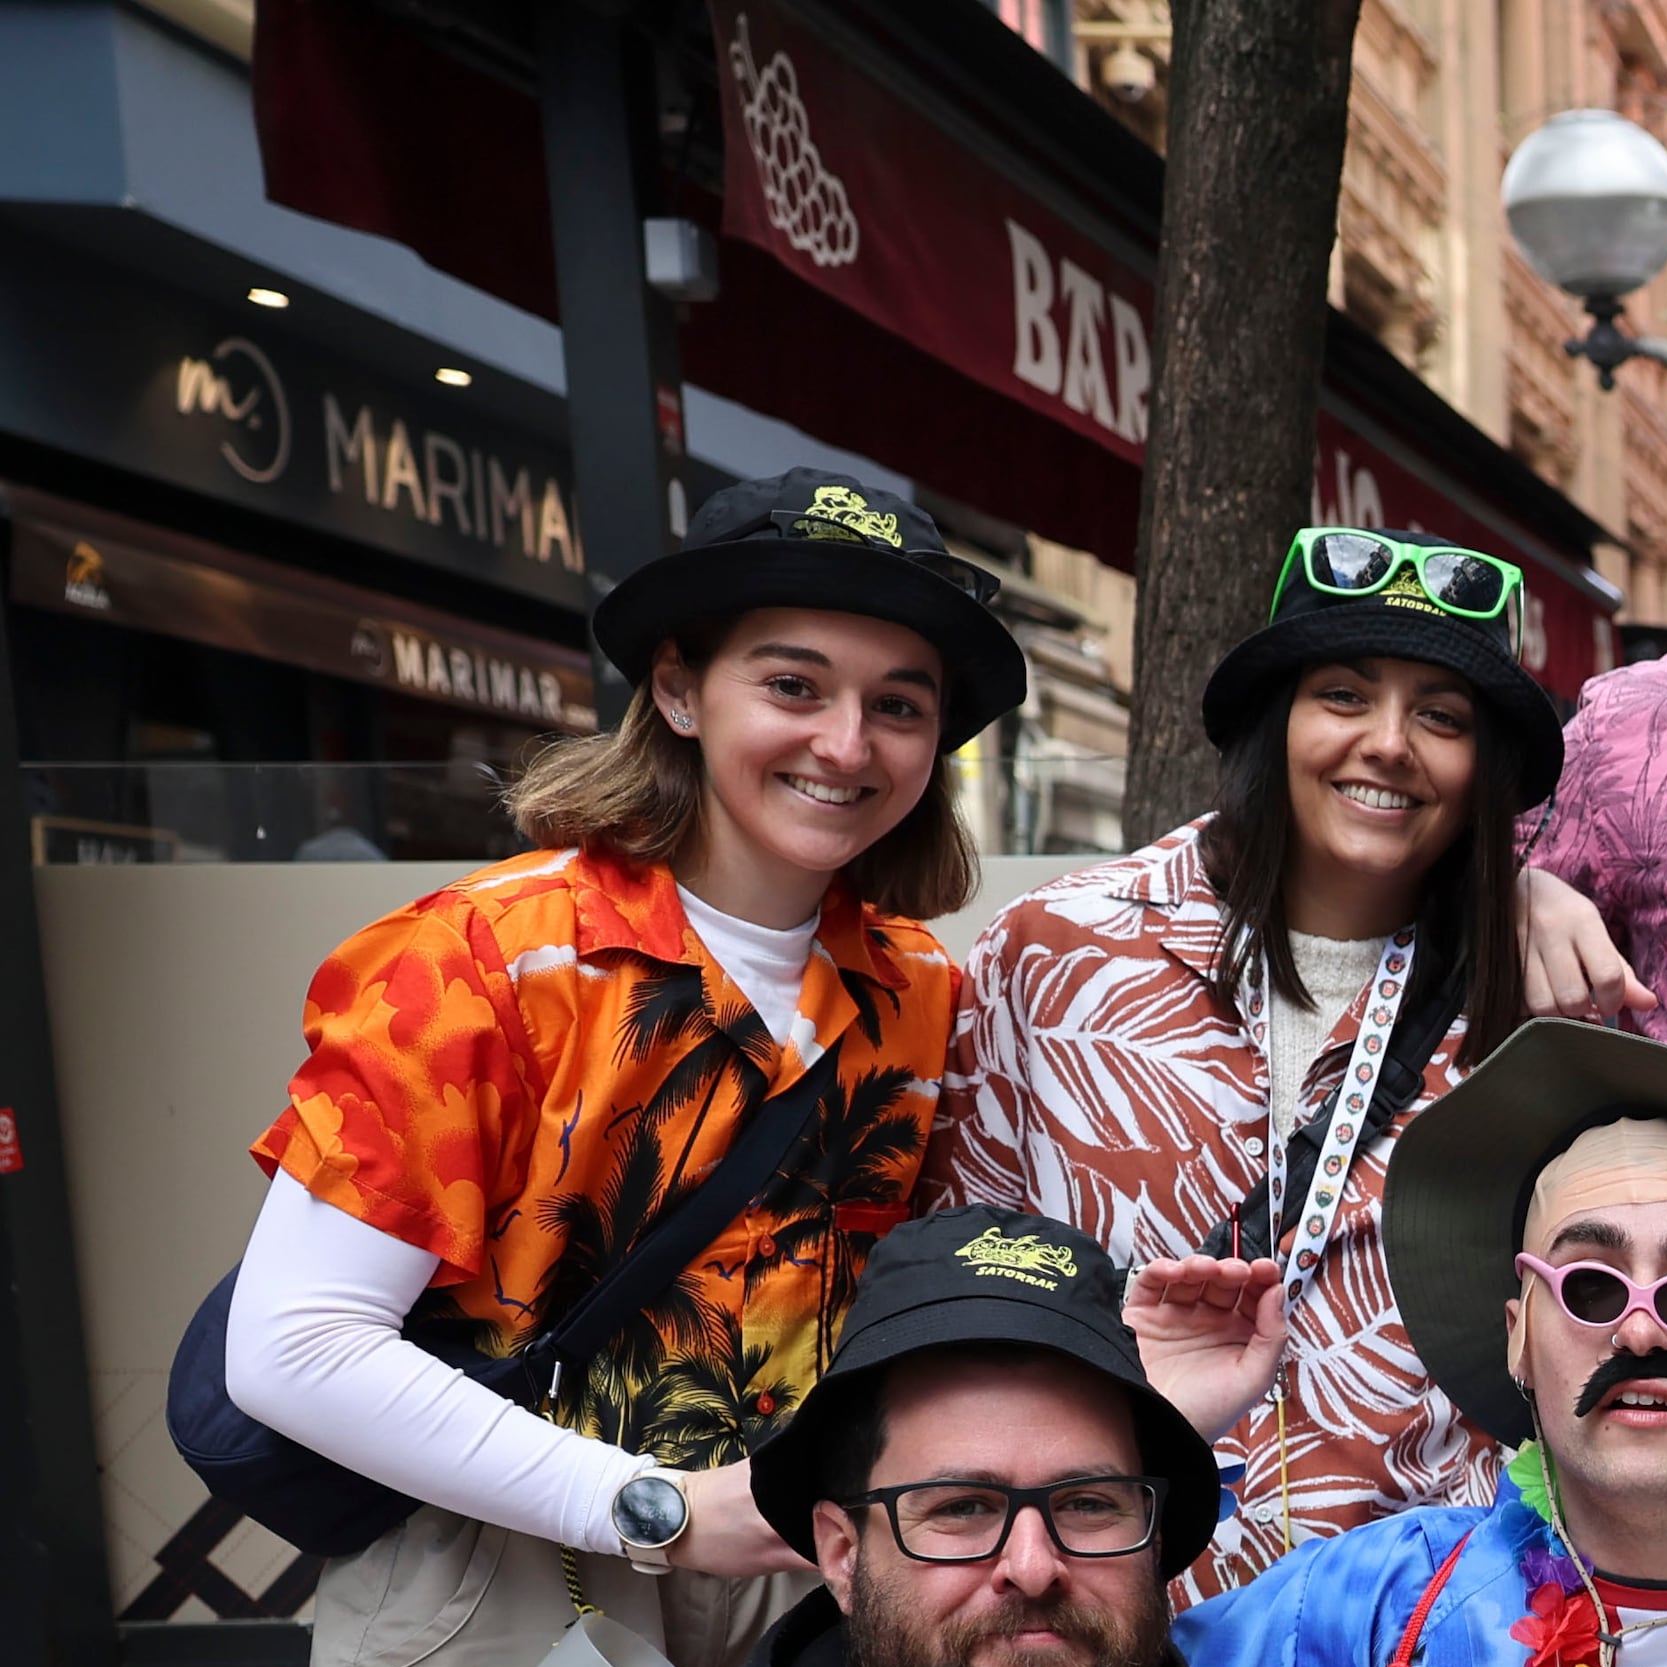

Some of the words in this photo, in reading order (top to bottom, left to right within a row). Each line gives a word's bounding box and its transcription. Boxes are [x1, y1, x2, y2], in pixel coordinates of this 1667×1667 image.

[1003, 215, 1151, 446] BAR
[392, 632, 563, 718] MARIMAR
[975, 1265, 1059, 1292] SATORRAK
